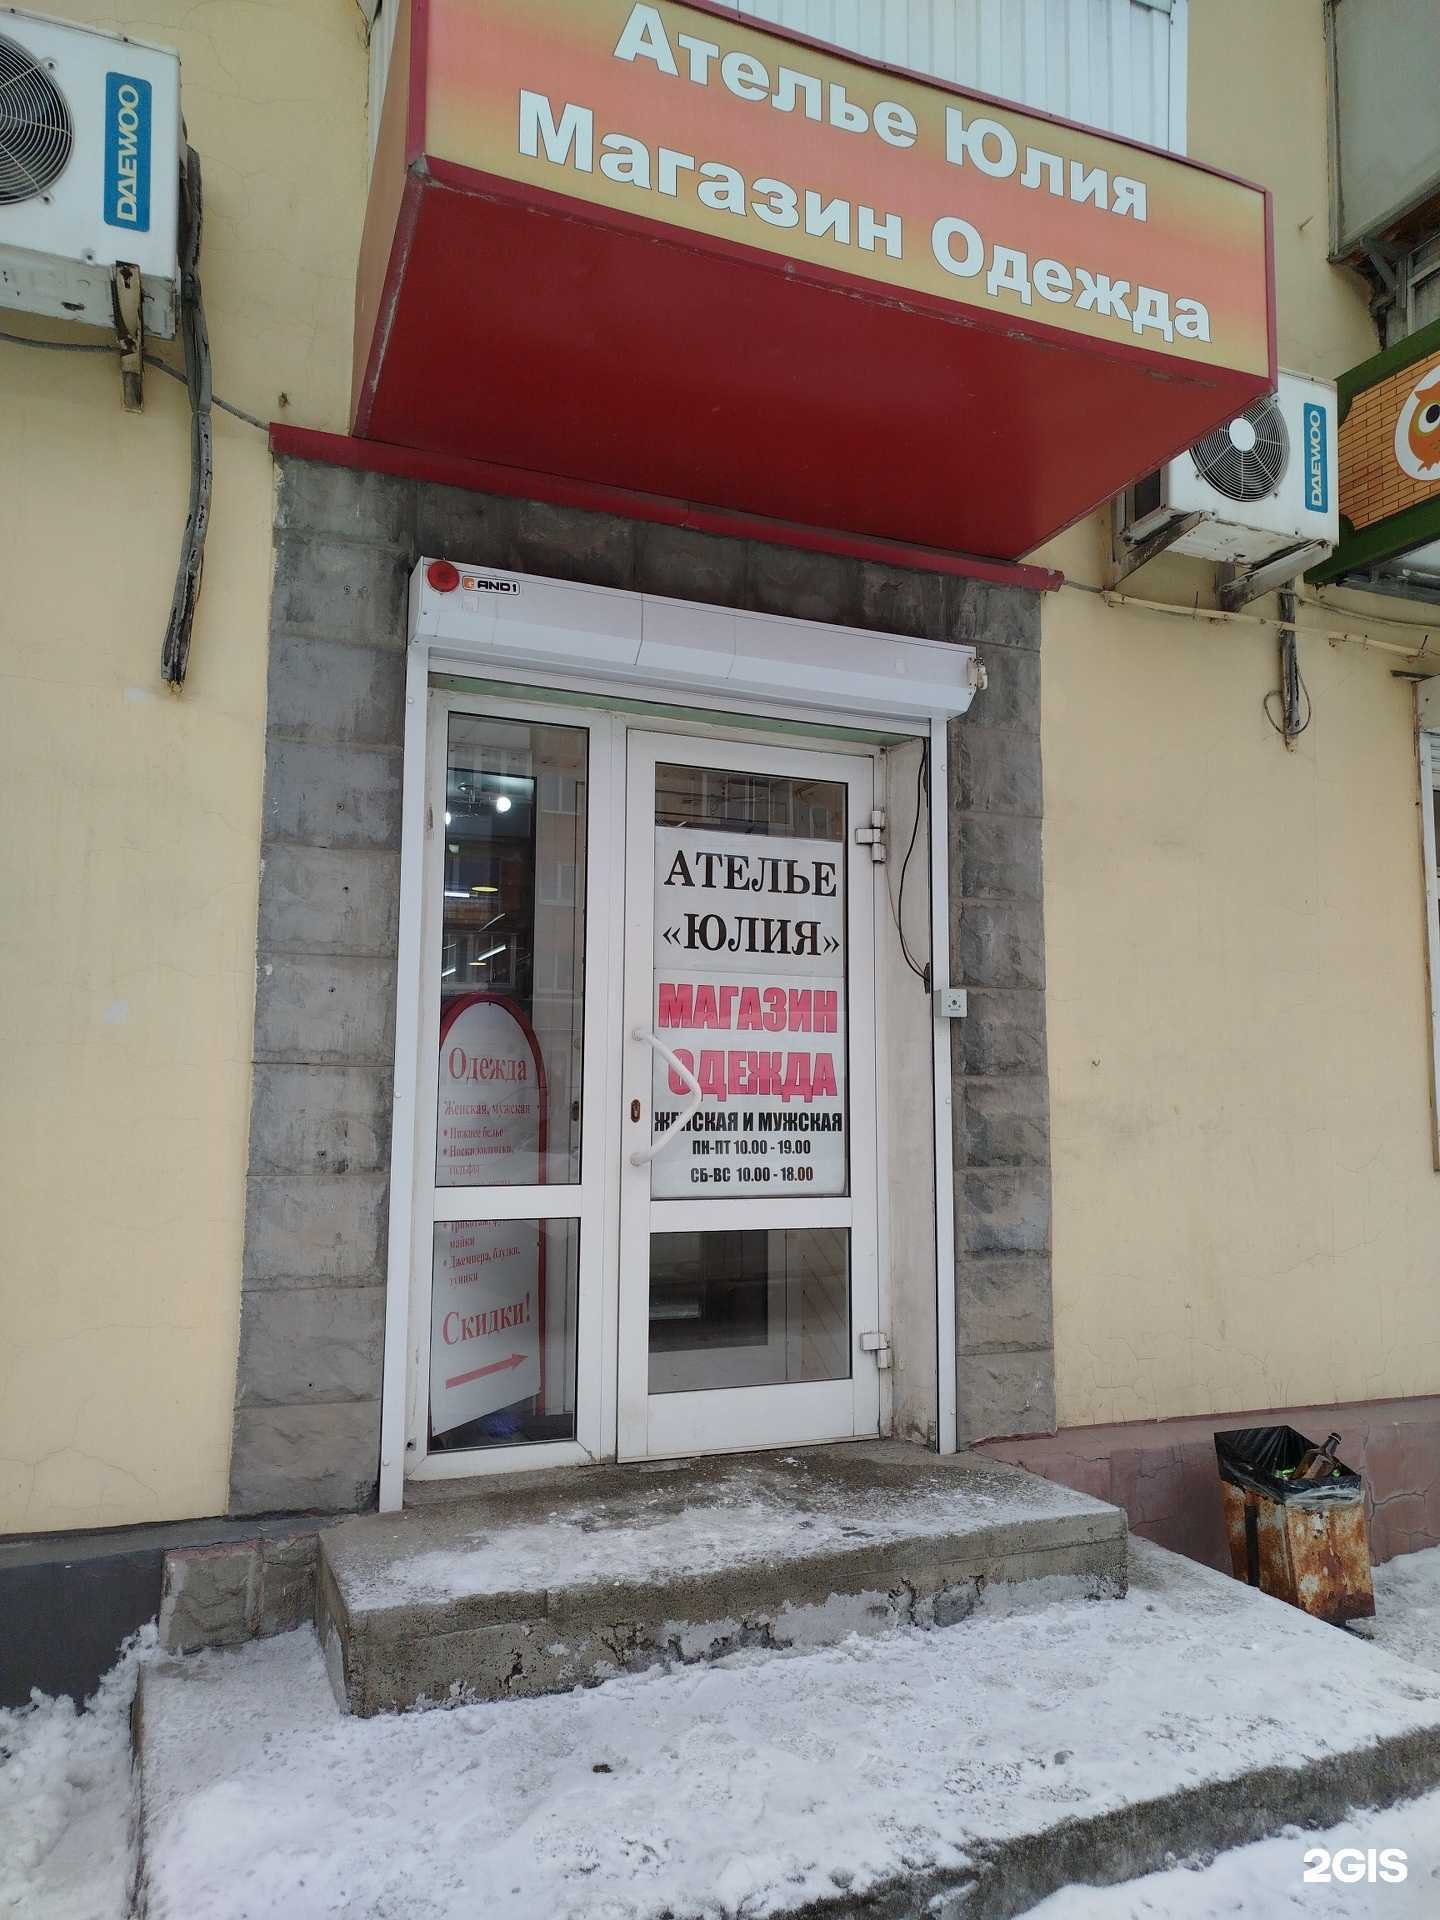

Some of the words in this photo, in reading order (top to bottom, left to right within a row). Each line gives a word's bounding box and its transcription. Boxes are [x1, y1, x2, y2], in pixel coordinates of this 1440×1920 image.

[612, 2, 919, 149] Ателье
[945, 105, 1149, 222] Юлия
[116, 84, 139, 222] DAEWOO
[518, 88, 904, 260] Магазин
[931, 216, 1213, 344] Одежда
[1310, 410, 1323, 506] DAEWOO
[664, 850, 838, 897] АТЕЛЬЕ
[663, 913, 840, 956] «ЮЛИЯ»
[658, 983, 838, 1034] МАГАЗИН
[449, 1047, 528, 1081] Одежда
[668, 1048, 838, 1102] ОДЕЖДА
[692, 1140, 731, 1155] ПН-ПТ
[735, 1140, 768, 1155] 10.00
[779, 1140, 811, 1155] 19.00
[742, 1112, 754, 1132] И
[758, 1112, 842, 1132] МУЖСКАЯ
[691, 1168, 731, 1183] СБ-ВС
[737, 1168, 770, 1182] 10.00
[780, 1167, 814, 1182] 18.00
[442, 1291, 532, 1346] Скидки!
